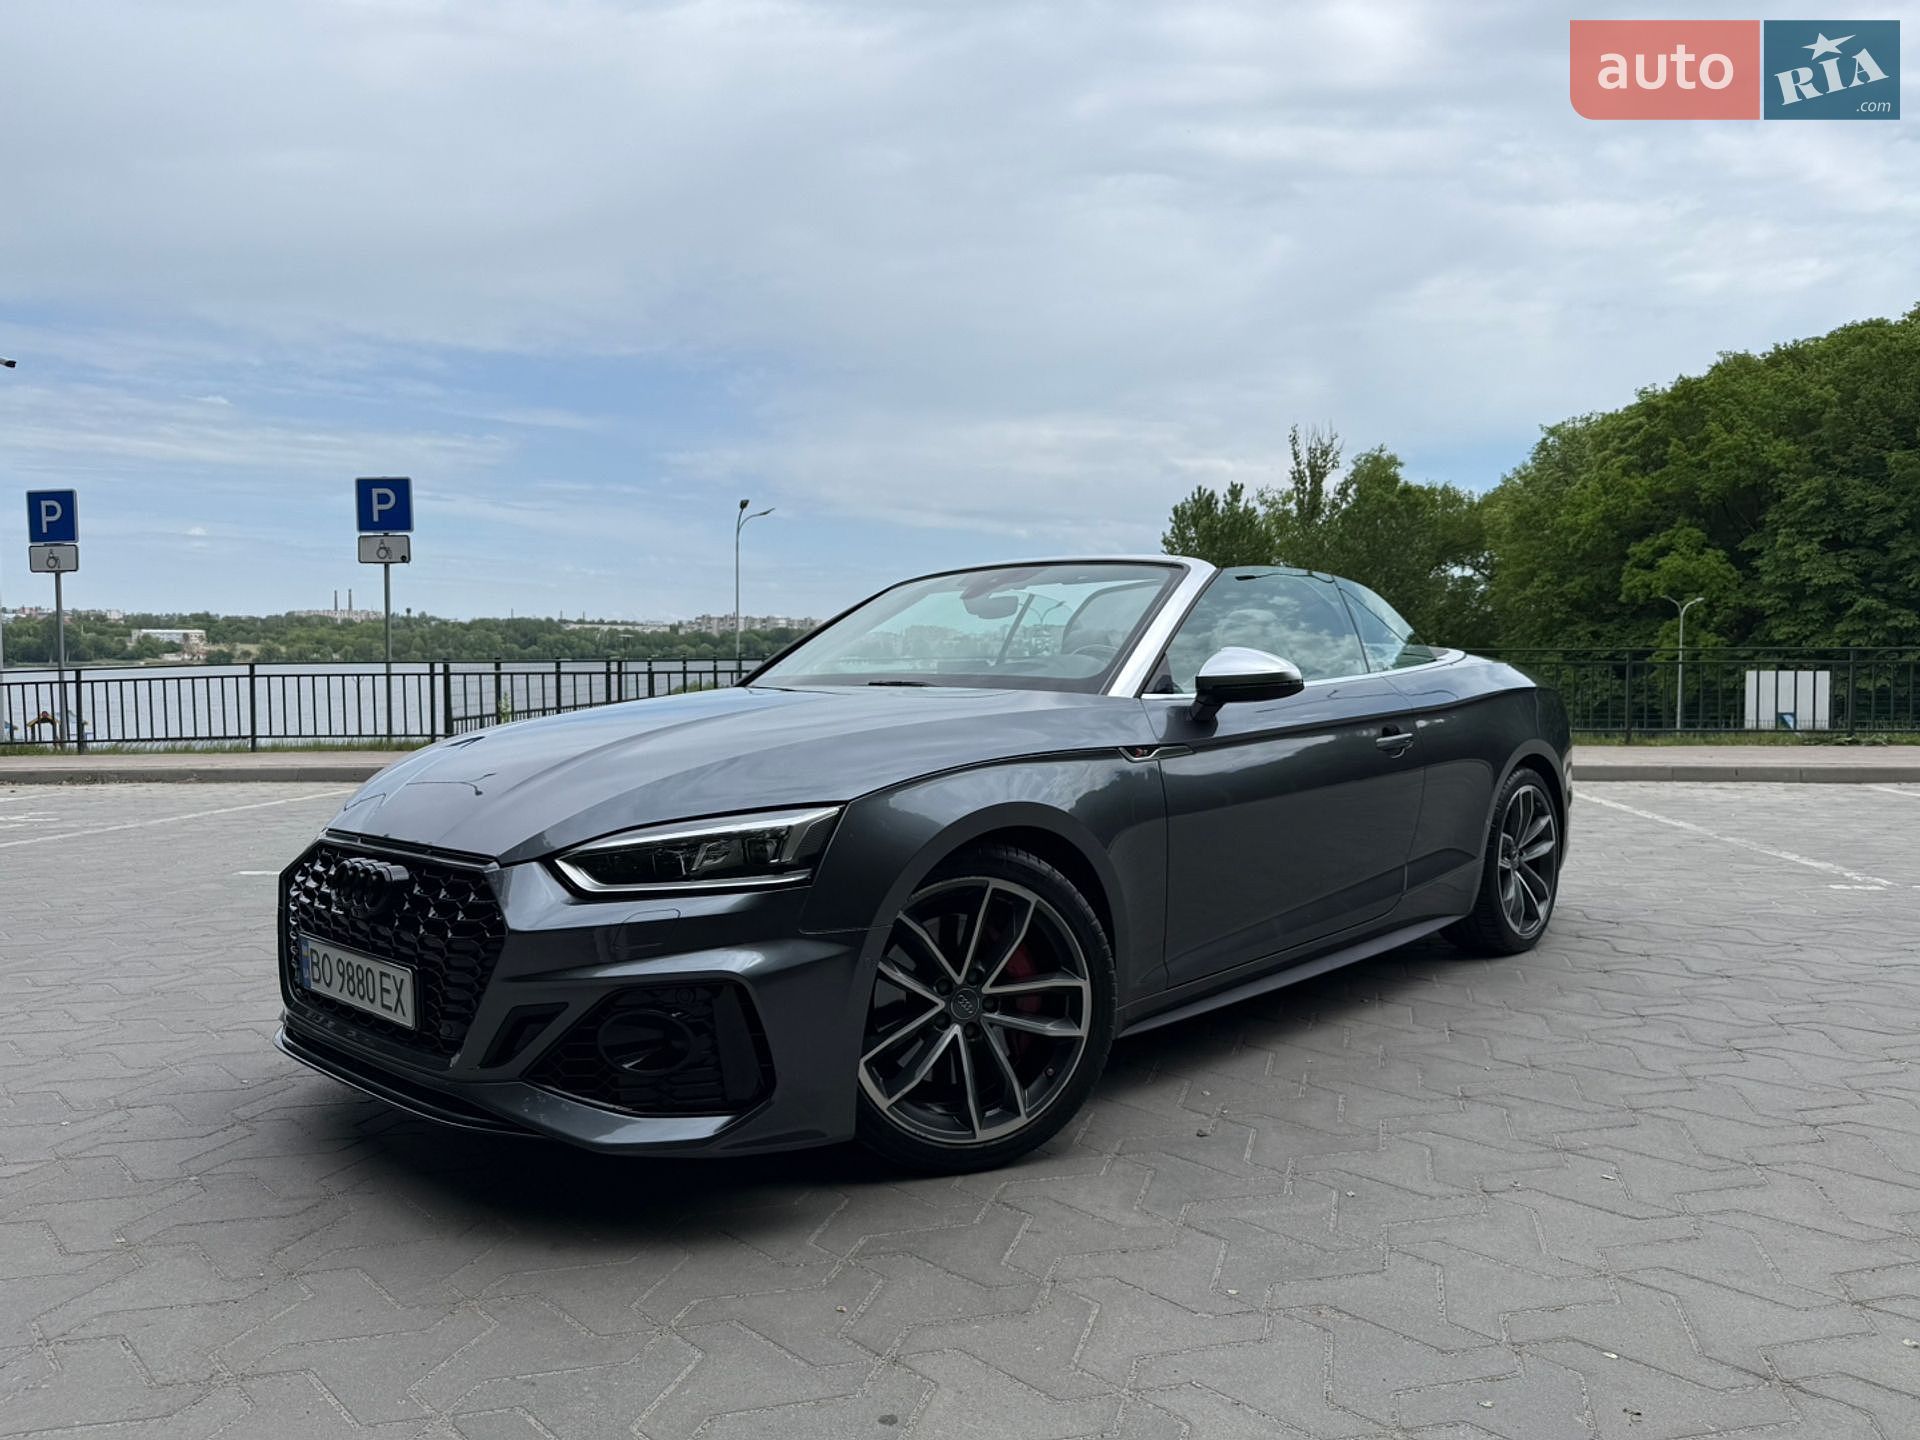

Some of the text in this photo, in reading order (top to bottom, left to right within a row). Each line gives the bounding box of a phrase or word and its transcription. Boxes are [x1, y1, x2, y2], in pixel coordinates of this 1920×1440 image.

[40, 499, 62, 534] P
[372, 487, 396, 522] P
[309, 948, 406, 1017] BO 9880 EX
